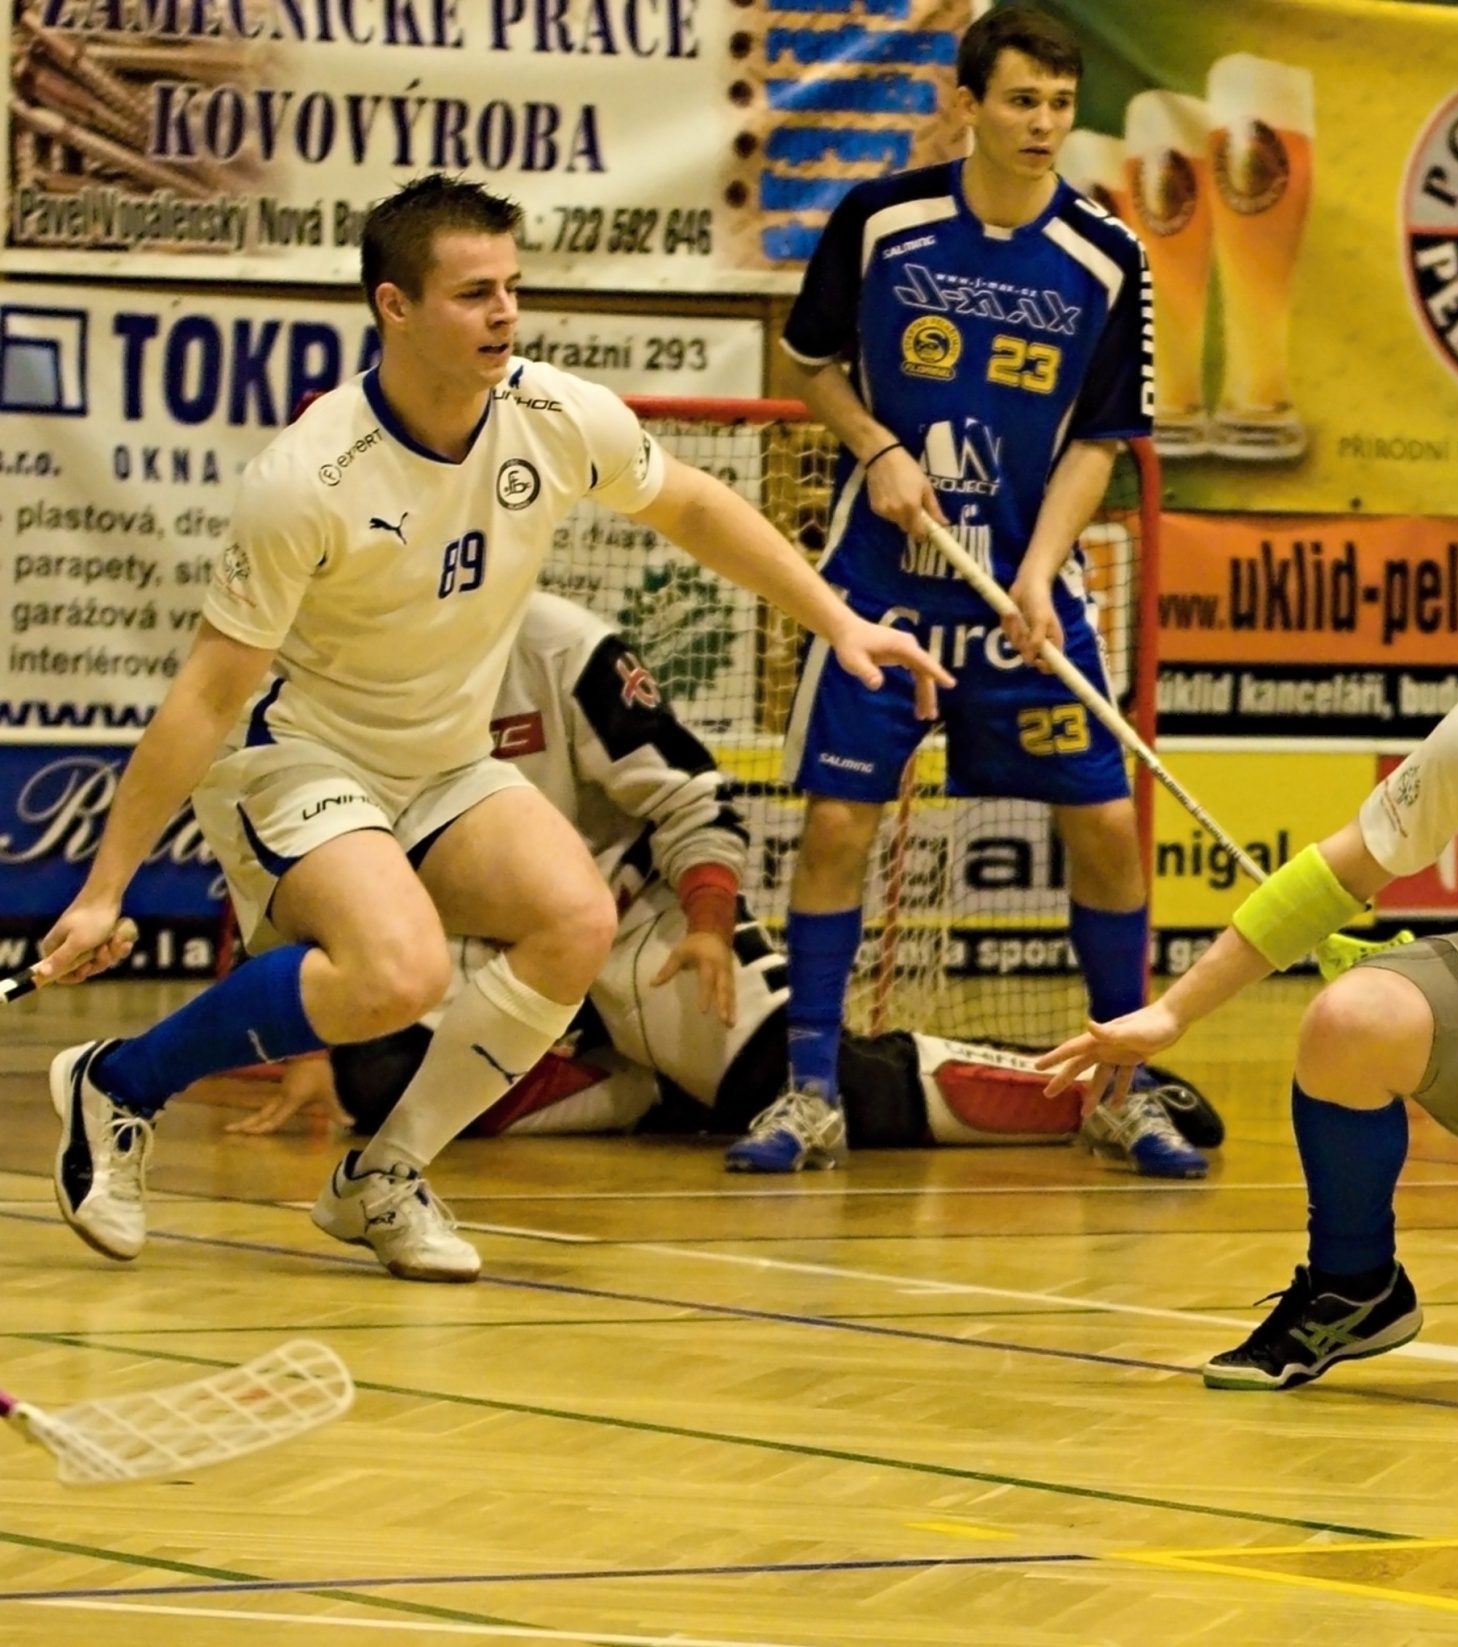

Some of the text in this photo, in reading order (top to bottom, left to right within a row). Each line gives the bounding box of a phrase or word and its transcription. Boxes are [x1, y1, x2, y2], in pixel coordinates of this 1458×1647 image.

[152, 78, 606, 173] KOVOVÝROBA
[258, 196, 322, 246] Nová
[552, 206, 604, 253] 723
[664, 208, 712, 255] 646
[883, 234, 937, 260] SALMING
[645, 337, 709, 371] 293
[986, 334, 1062, 395] 23
[113, 444, 219, 484] OKNA
[929, 474, 1000, 497] ROJECT
[15, 500, 165, 541] plastová,
[14, 553, 163, 591] parapety,
[438, 529, 487, 600] 89
[12, 597, 158, 635] garážová
[8, 642, 180, 679] interiérové
[1017, 703, 1092, 757] 23
[819, 752, 875, 774] SALMING
